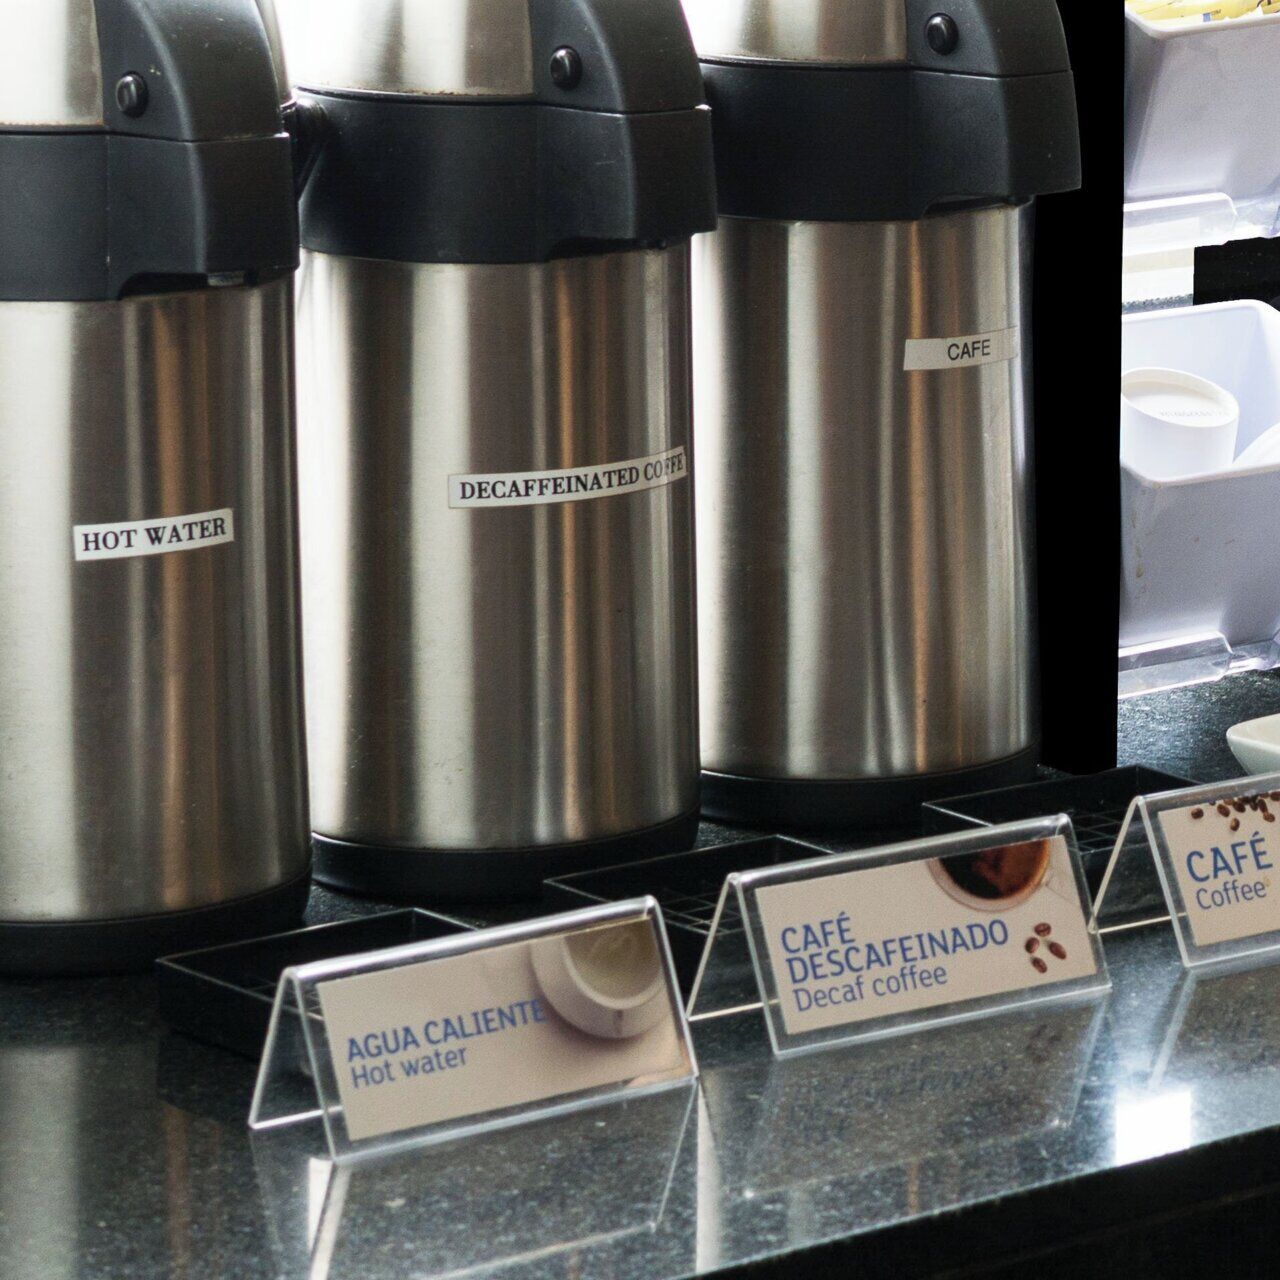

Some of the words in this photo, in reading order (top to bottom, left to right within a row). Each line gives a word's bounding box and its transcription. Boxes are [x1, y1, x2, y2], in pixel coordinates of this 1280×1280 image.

[948, 339, 991, 361] CAFE
[460, 466, 640, 500] DECAFFEINATED
[82, 529, 138, 552] HOT
[144, 517, 226, 547] WATER
[1186, 831, 1273, 883] CAFÉ
[1196, 880, 1267, 910] Coffee
[781, 911, 856, 954] CAFÉ
[785, 919, 1009, 984] DESCAFEINADO
[793, 974, 864, 1012] Decaf
[872, 965, 948, 997] coffee
[347, 1026, 420, 1063] AGUA
[424, 998, 547, 1046] CALIENTE
[352, 1059, 395, 1089] Hot
[400, 1046, 467, 1078] water
